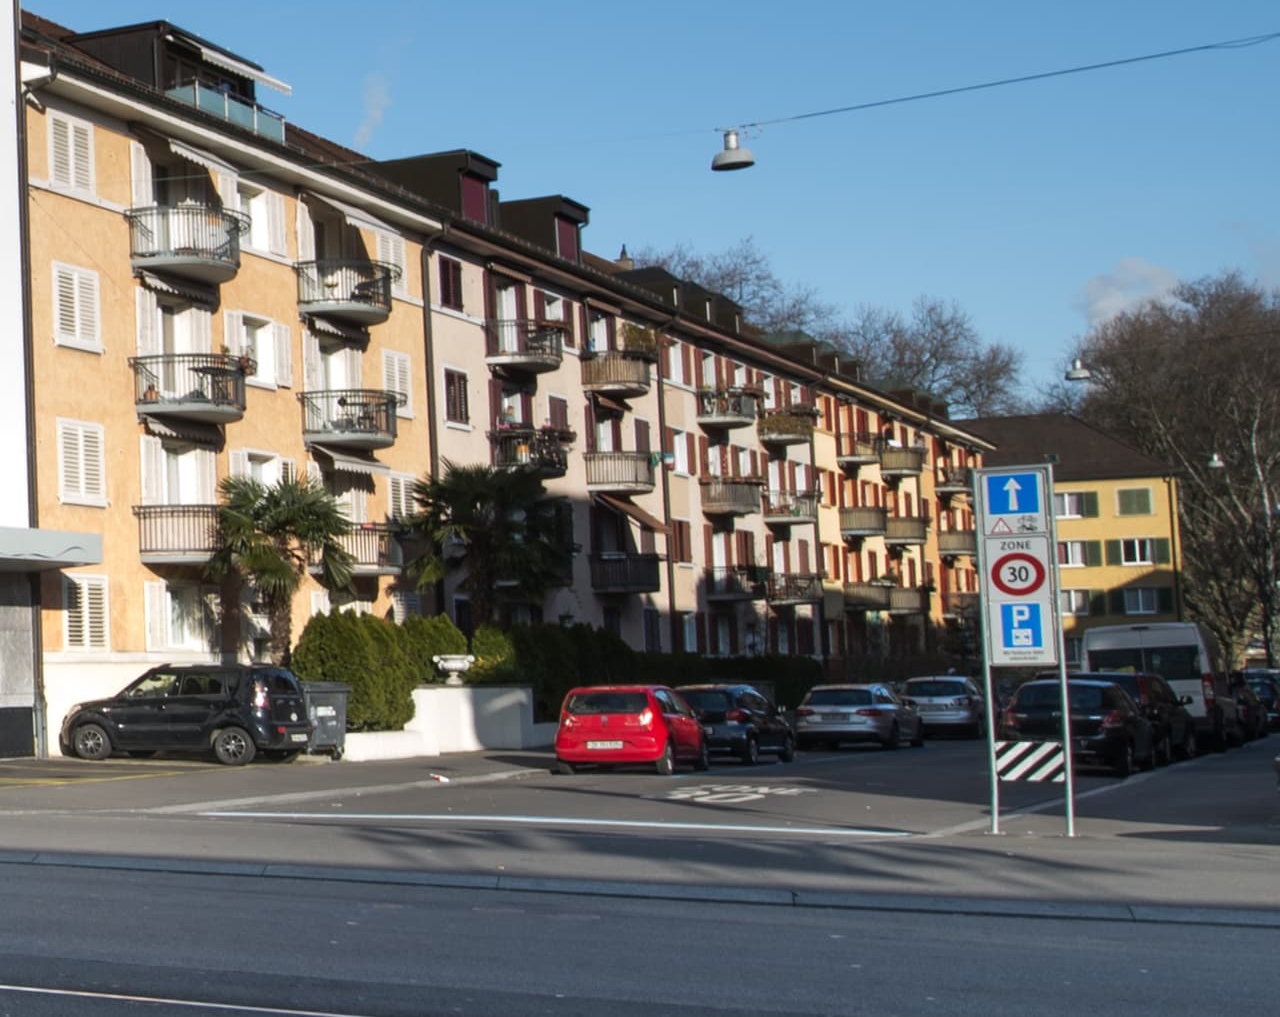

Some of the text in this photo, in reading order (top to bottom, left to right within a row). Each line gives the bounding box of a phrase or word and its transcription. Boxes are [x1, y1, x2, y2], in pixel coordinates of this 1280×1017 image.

[1000, 540, 1032, 550] ZONE
[1007, 566, 1029, 583] 30
[1012, 606, 1030, 627] P
